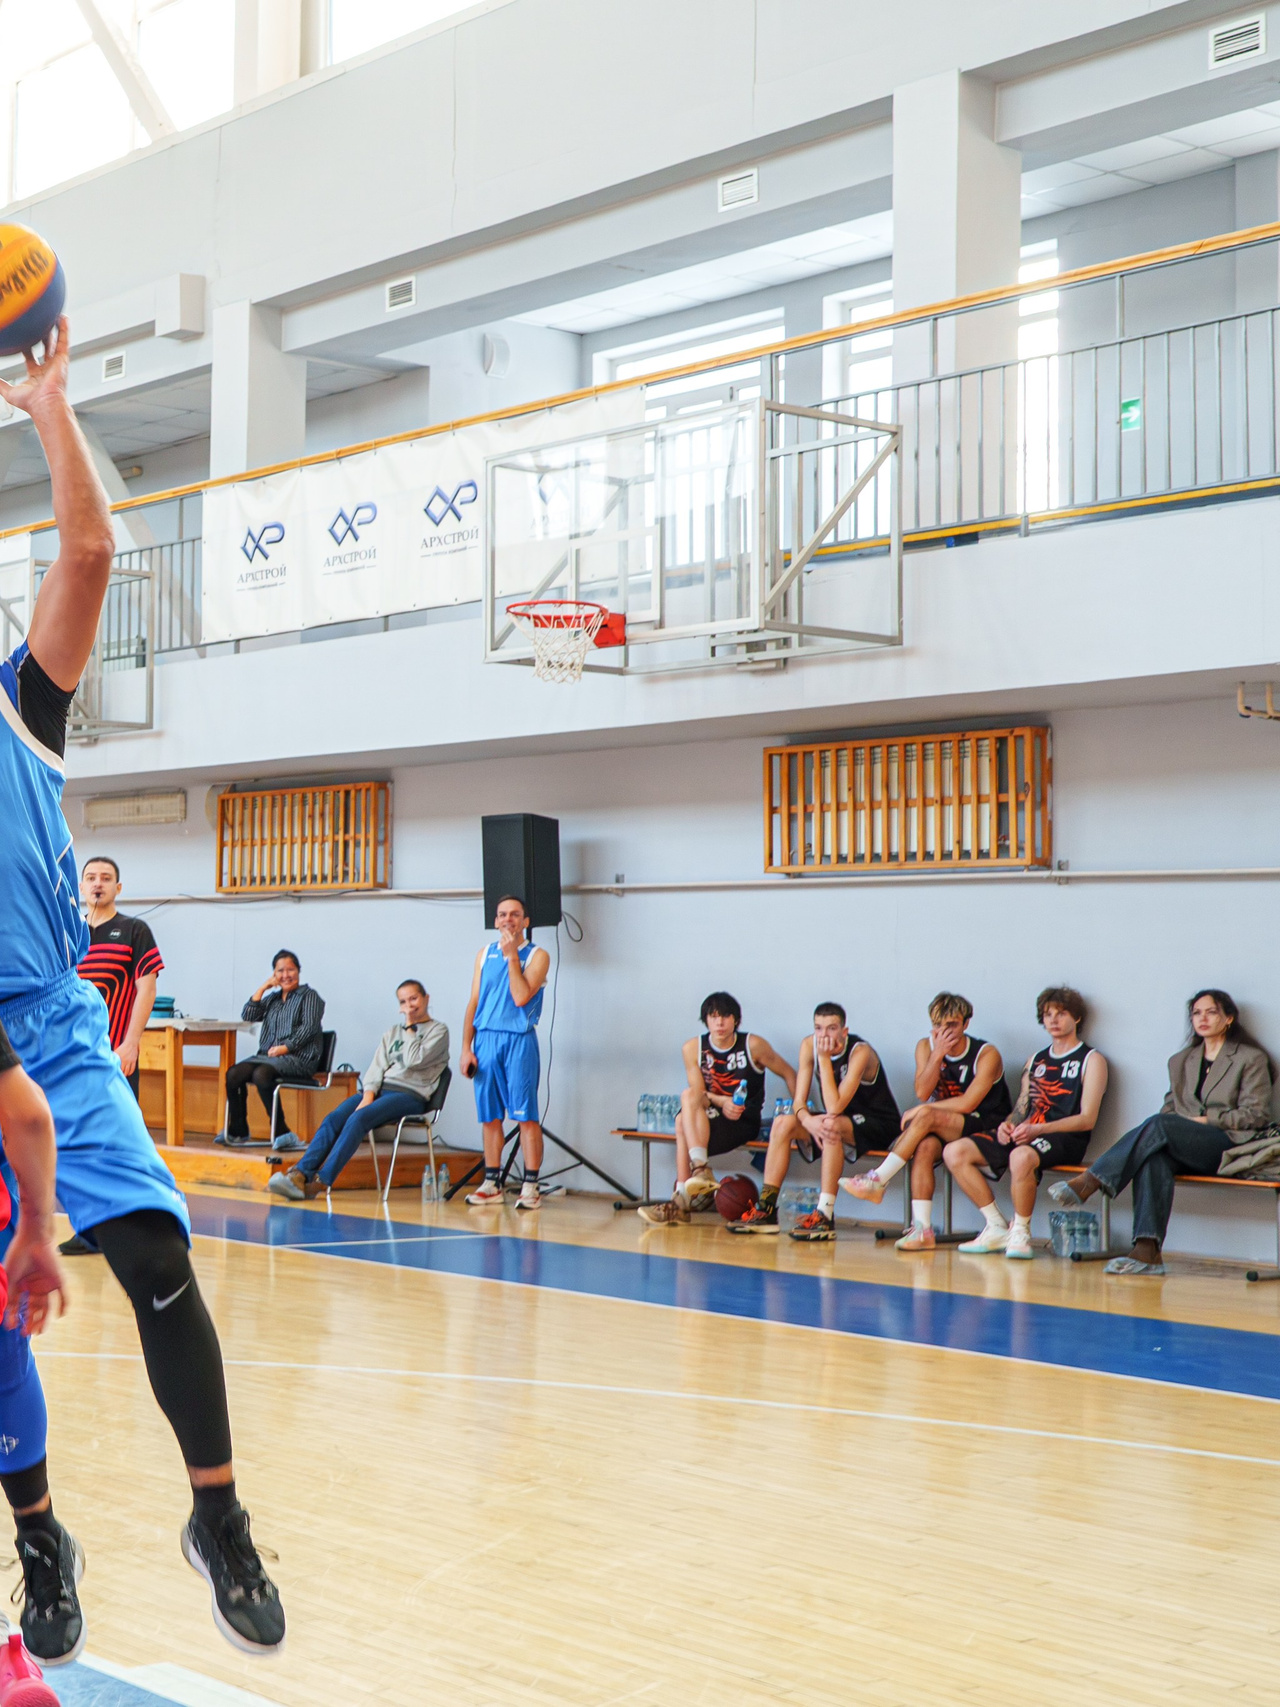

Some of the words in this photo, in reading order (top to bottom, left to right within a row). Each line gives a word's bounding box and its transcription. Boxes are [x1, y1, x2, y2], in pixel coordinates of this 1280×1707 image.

[420, 526, 480, 549] АРХСТРОЙ
[323, 546, 378, 568] АРХСТРОЙ
[236, 564, 287, 584] АРХСТРОЙ
[958, 1064, 969, 1084] 7
[1060, 1060, 1082, 1079] 13
